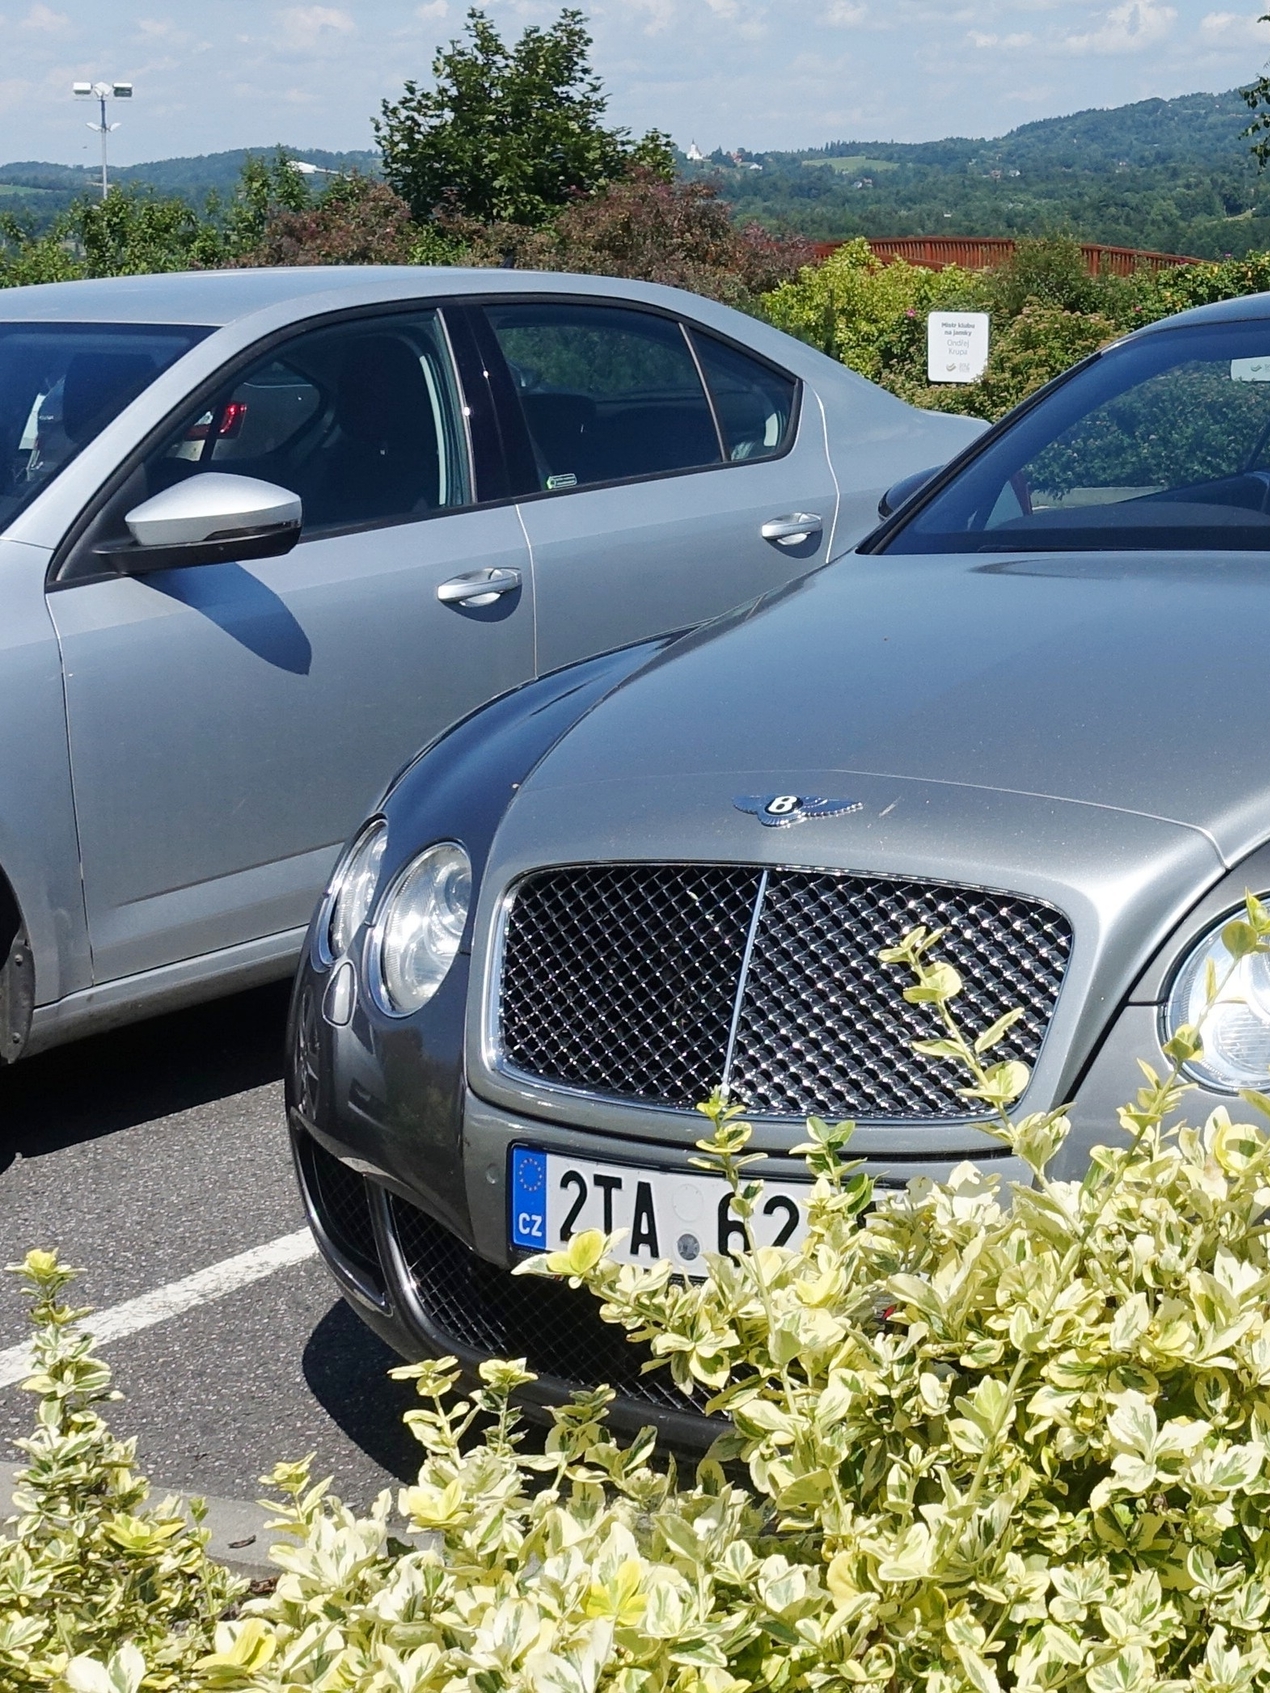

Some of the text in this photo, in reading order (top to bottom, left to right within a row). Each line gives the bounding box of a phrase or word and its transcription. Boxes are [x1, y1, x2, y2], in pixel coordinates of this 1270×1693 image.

[948, 348, 968, 356] Krupa
[768, 795, 798, 812] B
[518, 1212, 543, 1237] CZ
[560, 1169, 660, 1259] 2TA
